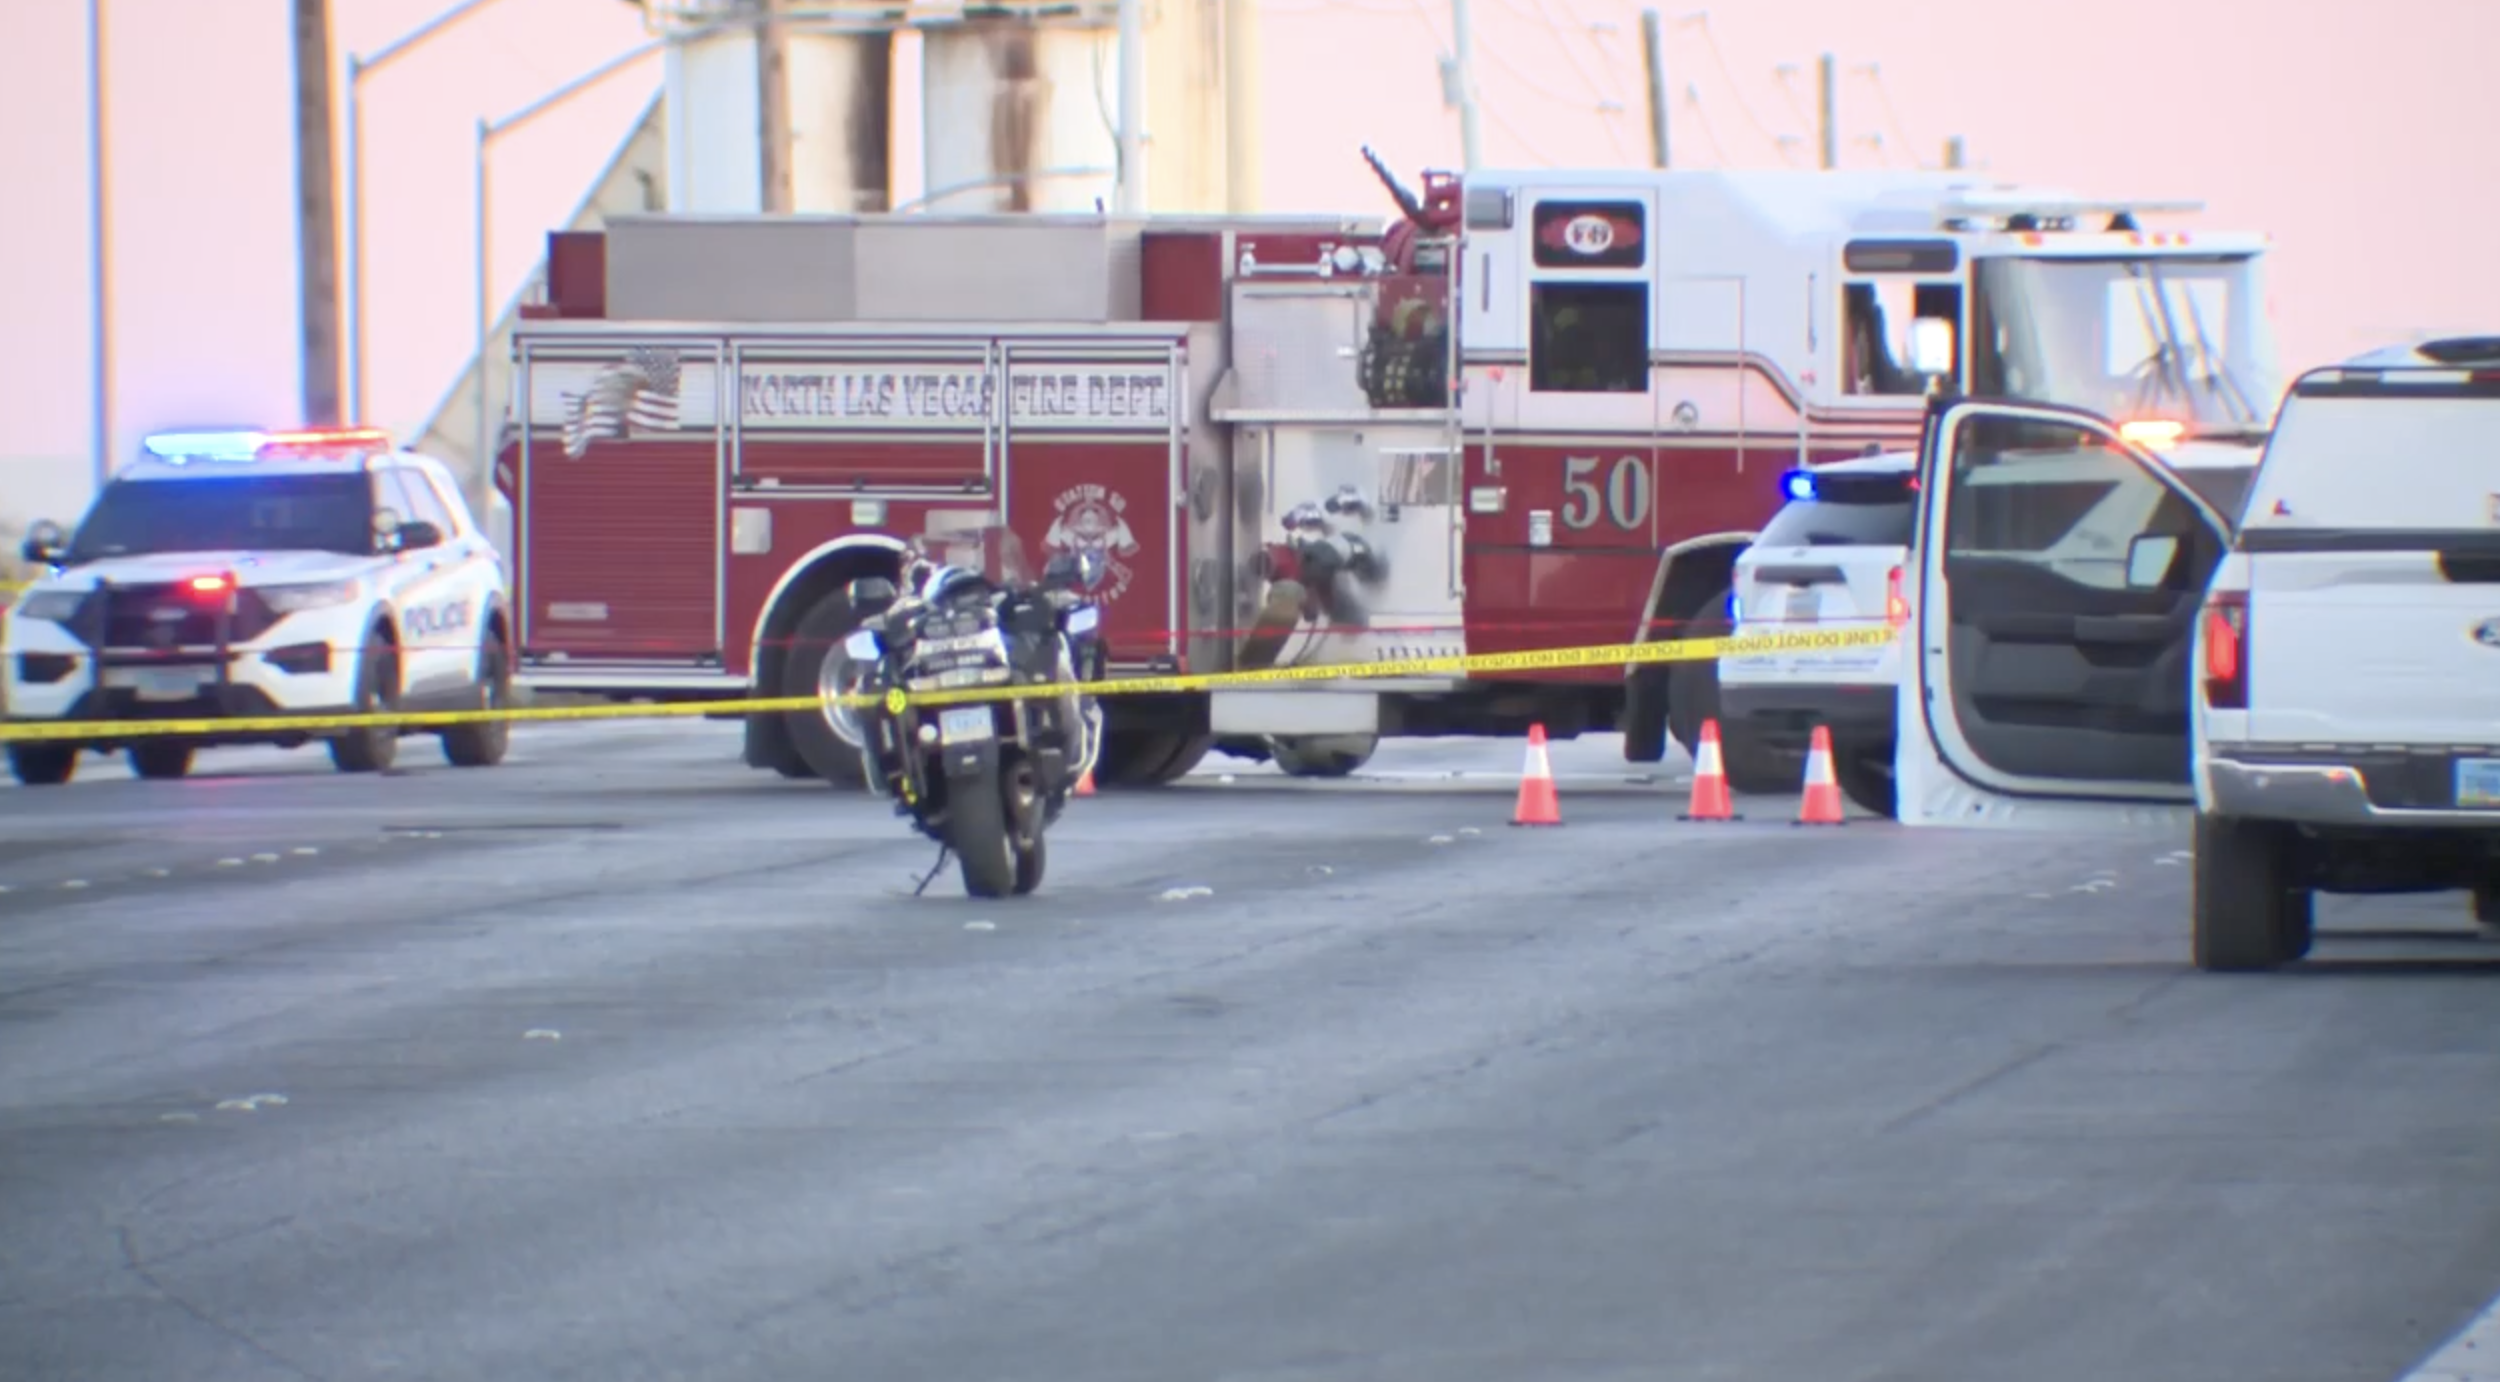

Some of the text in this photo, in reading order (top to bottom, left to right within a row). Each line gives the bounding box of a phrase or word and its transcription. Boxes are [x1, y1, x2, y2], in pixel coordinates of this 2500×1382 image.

[742, 374, 835, 416] NORTH
[843, 374, 894, 416] LAS
[902, 374, 997, 417] VEGAS
[1011, 374, 1077, 416] FIRE
[1561, 455, 1650, 531] 50
[403, 599, 472, 640] POLICE
[1778, 633, 1812, 650] NOT
[1814, 631, 1841, 648] DO
[1844, 629, 1881, 647] LINE
[1626, 643, 1684, 661] POLICE
